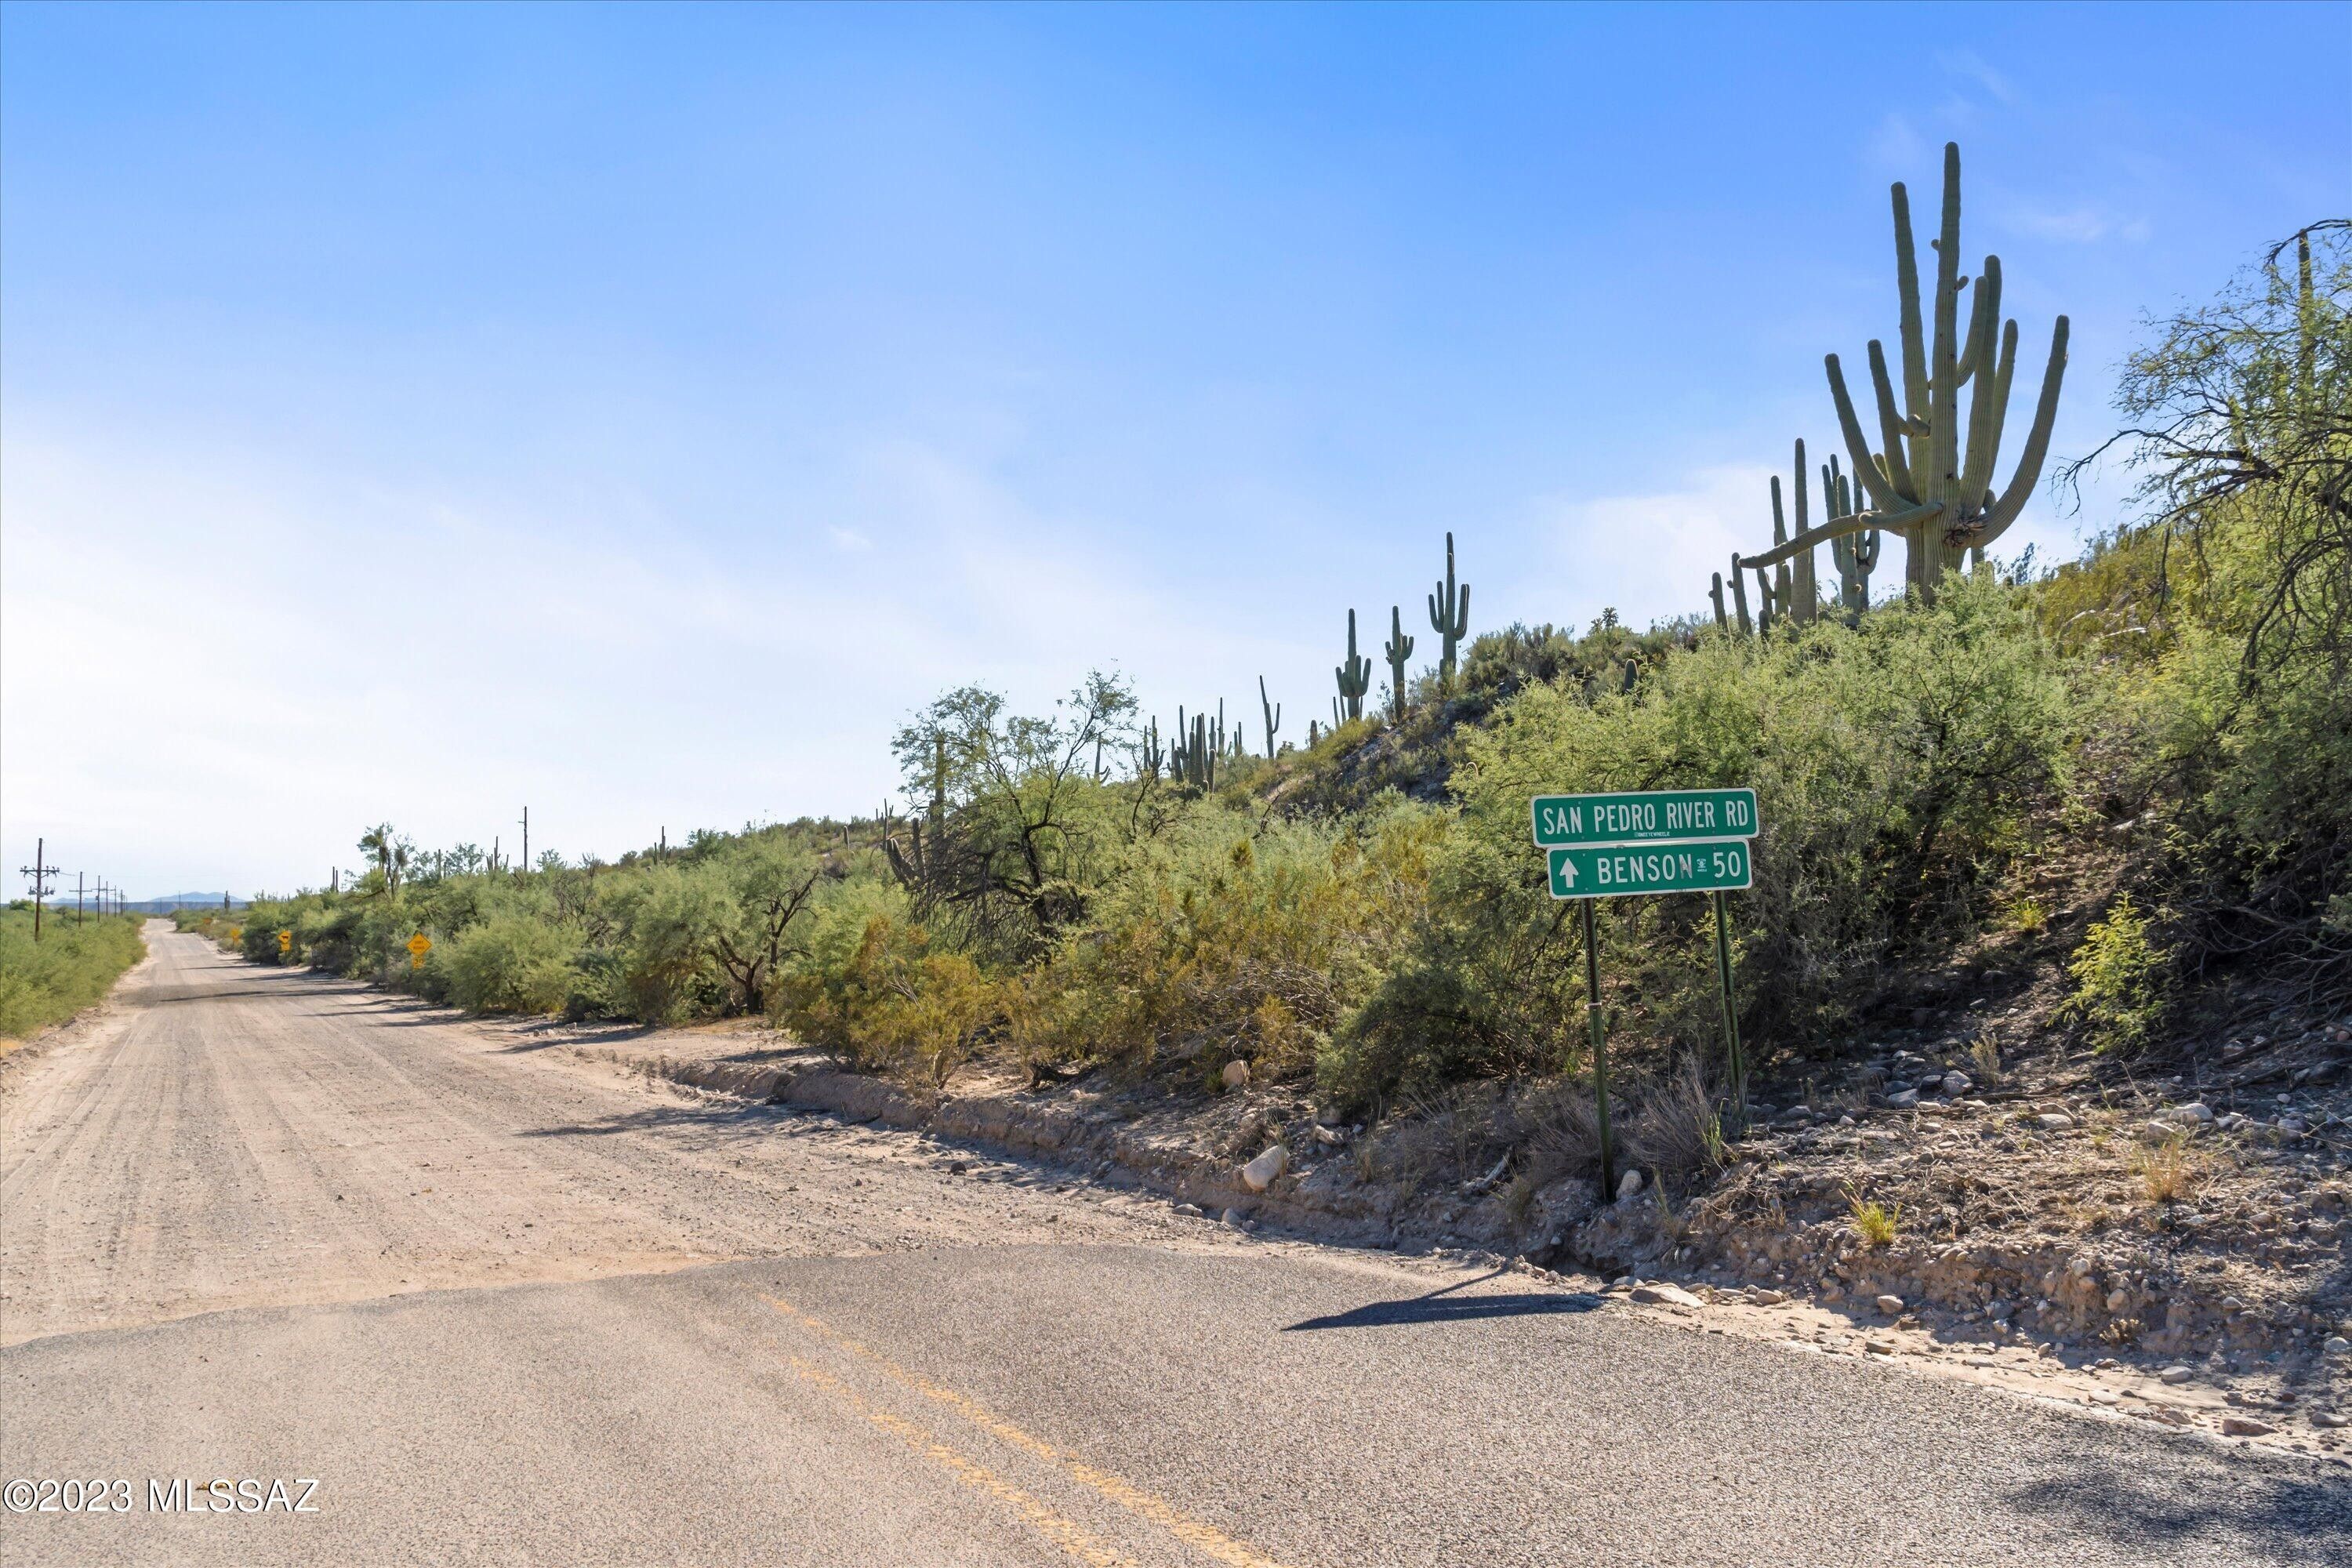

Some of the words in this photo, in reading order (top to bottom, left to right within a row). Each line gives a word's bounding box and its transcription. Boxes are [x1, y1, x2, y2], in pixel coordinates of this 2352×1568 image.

[1543, 806, 1582, 835] SAN
[1593, 803, 1656, 833] PEDRO
[1666, 801, 1715, 829] RIVER
[1725, 800, 1748, 827] RD
[1597, 853, 1693, 884] BENSON
[1713, 851, 1741, 878] 50
